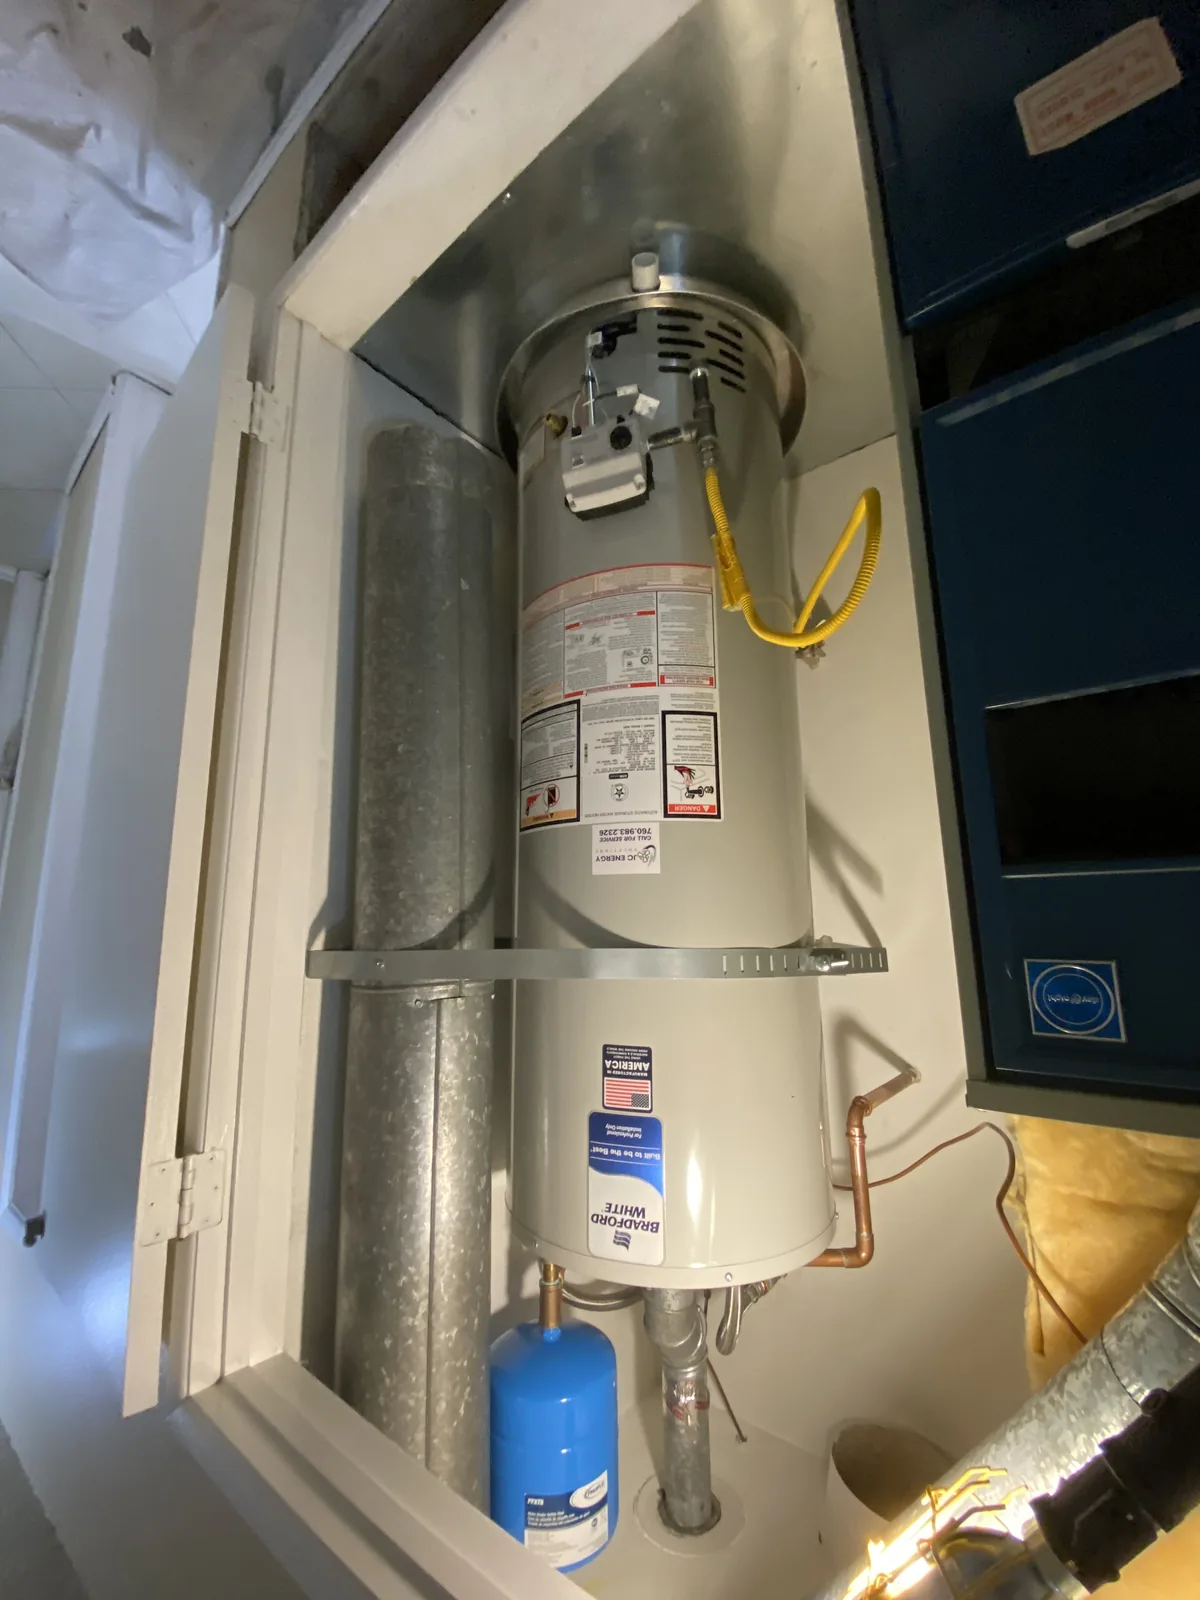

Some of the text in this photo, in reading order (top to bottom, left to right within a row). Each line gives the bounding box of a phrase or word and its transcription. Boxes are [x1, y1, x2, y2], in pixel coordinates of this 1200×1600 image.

[599, 828, 652, 836] 760.983.2326
[605, 1060, 650, 1071] AMERICA
[606, 1130, 634, 1138] Professional
[591, 1203, 660, 1234] BRADFORD WHITE
